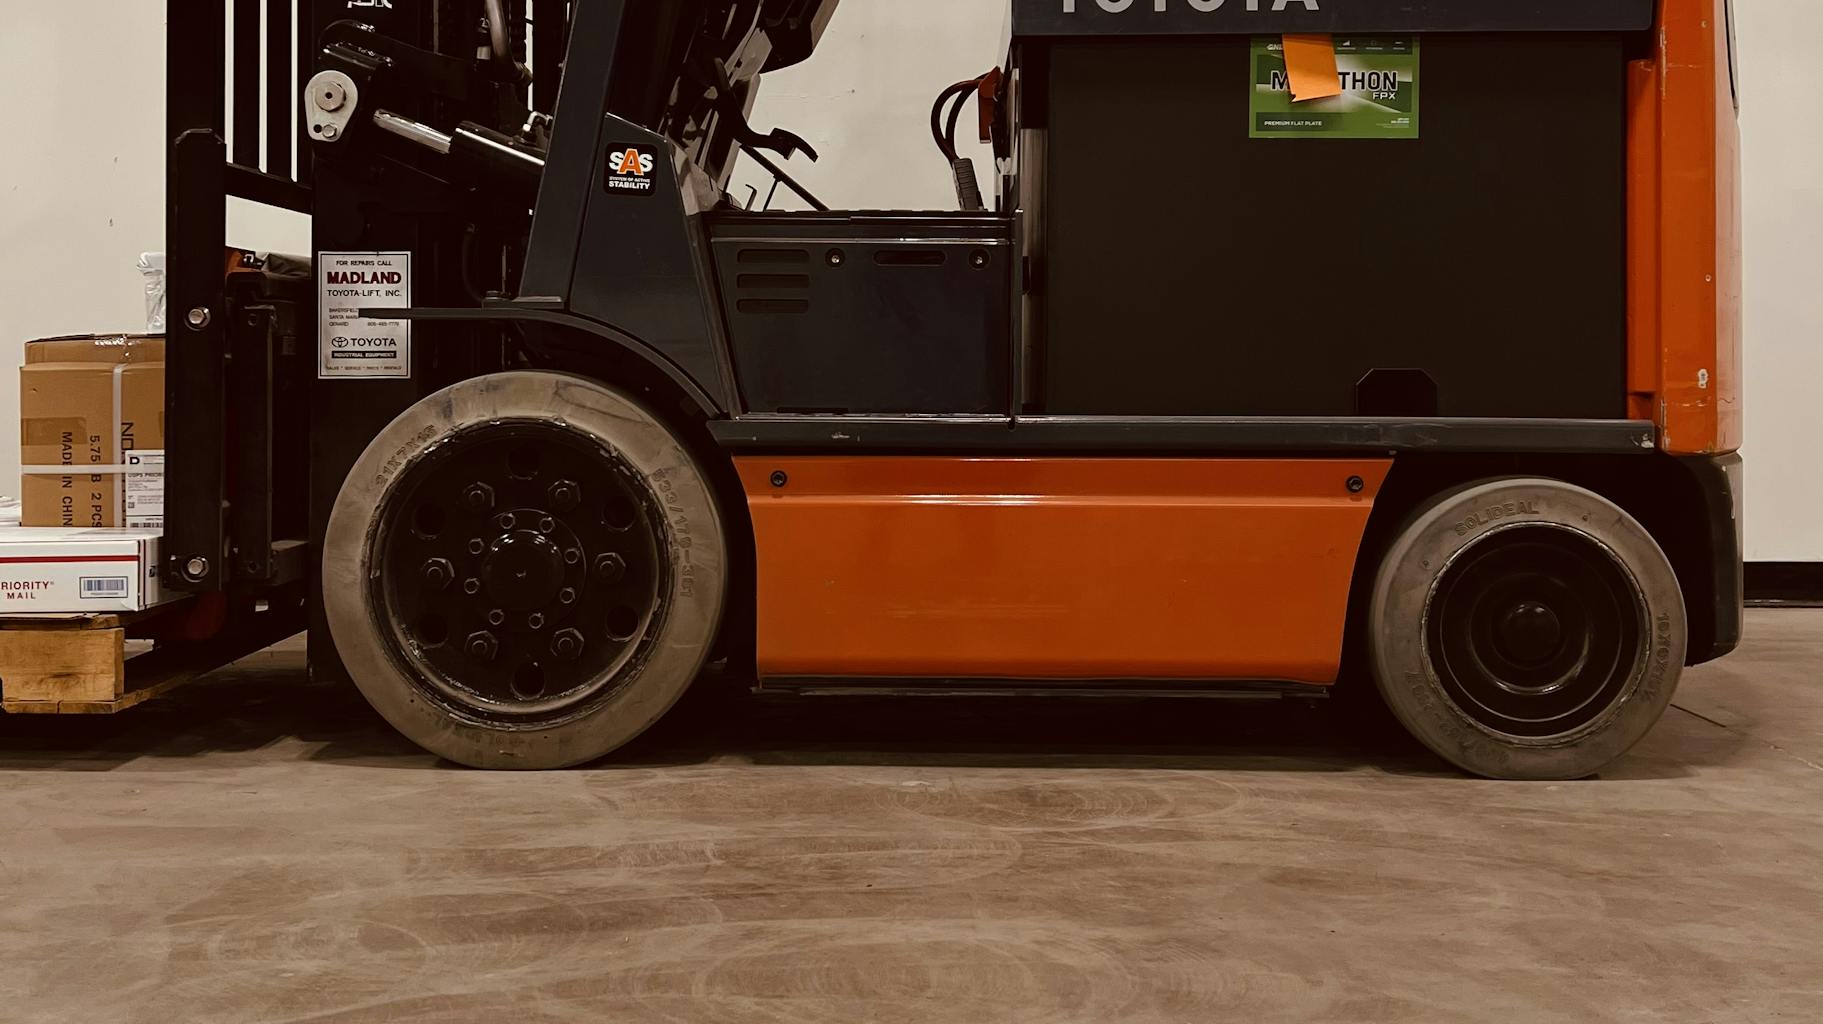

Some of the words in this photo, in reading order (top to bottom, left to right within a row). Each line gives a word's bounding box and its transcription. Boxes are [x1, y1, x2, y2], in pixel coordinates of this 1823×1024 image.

[1271, 70, 1398, 91] MTHON
[1372, 92, 1396, 100] FPX
[608, 148, 654, 176] SAS
[609, 181, 650, 189] STABILITY
[327, 271, 402, 284] MADLAND
[385, 289, 402, 297] INC.
[350, 337, 397, 347] TOYOTA
[90, 435, 101, 462] 5.75
[61, 476, 72, 488] IN
[91, 492, 102, 501] 2
[61, 496, 72, 527] CHIN
[1454, 501, 1540, 537] SOLIDEAL
[0, 581, 49, 590] RIORITY
[6, 592, 36, 600] MAIL
